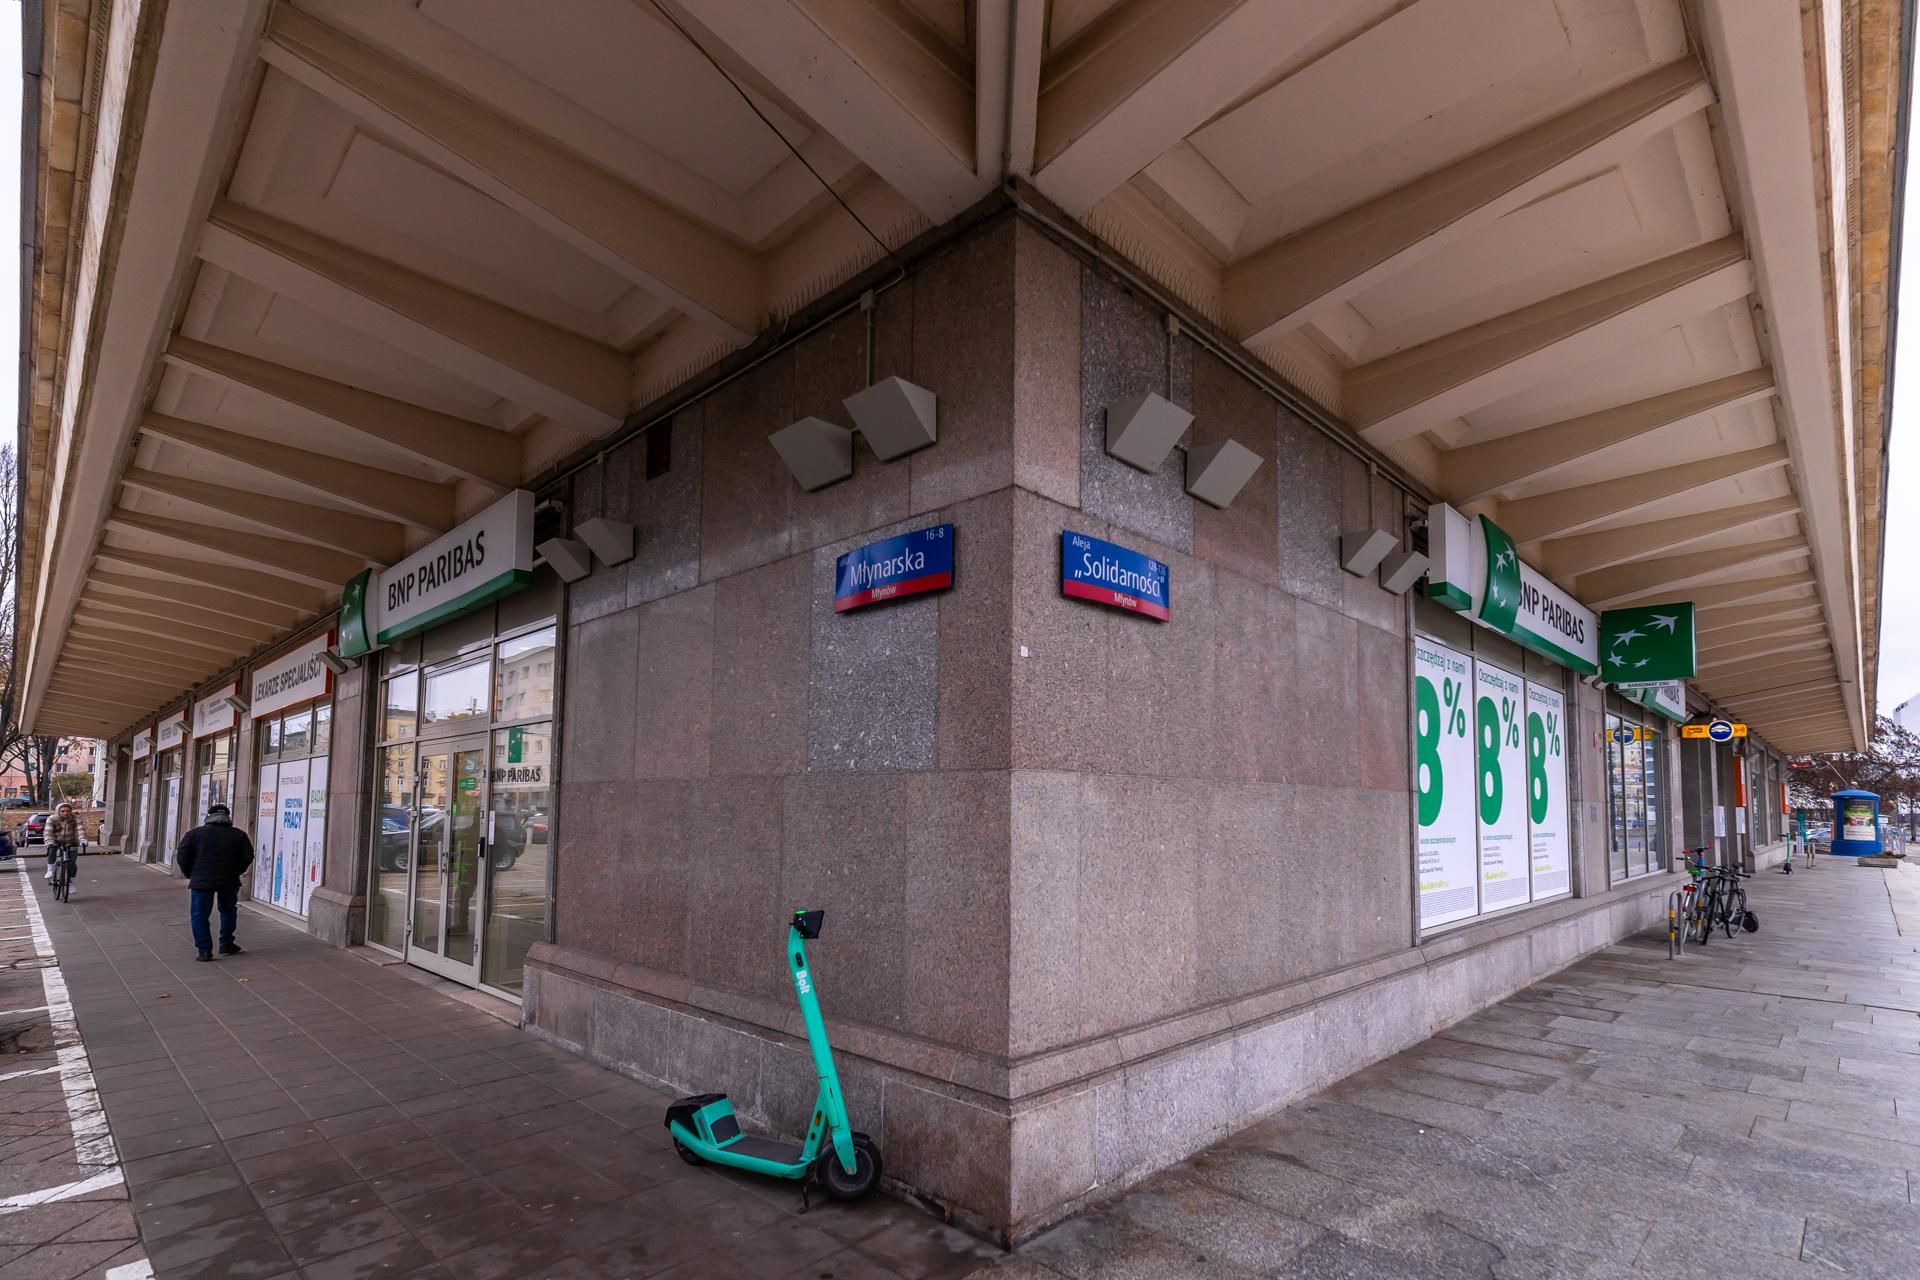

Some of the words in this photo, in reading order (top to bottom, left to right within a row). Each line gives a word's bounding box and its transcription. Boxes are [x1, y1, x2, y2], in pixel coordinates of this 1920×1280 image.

[926, 527, 944, 541] 16-8
[1072, 536, 1091, 551] Aleja
[388, 573, 414, 611] BNP
[418, 530, 485, 596] PARIBAS
[851, 547, 924, 589] Młynarska
[871, 585, 897, 600] Młynów
[1114, 592, 1137, 608] Młynów
[1542, 594, 1584, 644] PARIBAS
[1415, 648, 1445, 672] szczędzaj
[255, 675, 279, 703] LEKARZE
[1477, 695, 1519, 826] 8%
[1528, 710, 1560, 825] 8%
[507, 768, 541, 783] PARIBAS
[284, 811, 303, 829] PRACY
[796, 969, 810, 994] Bolt
